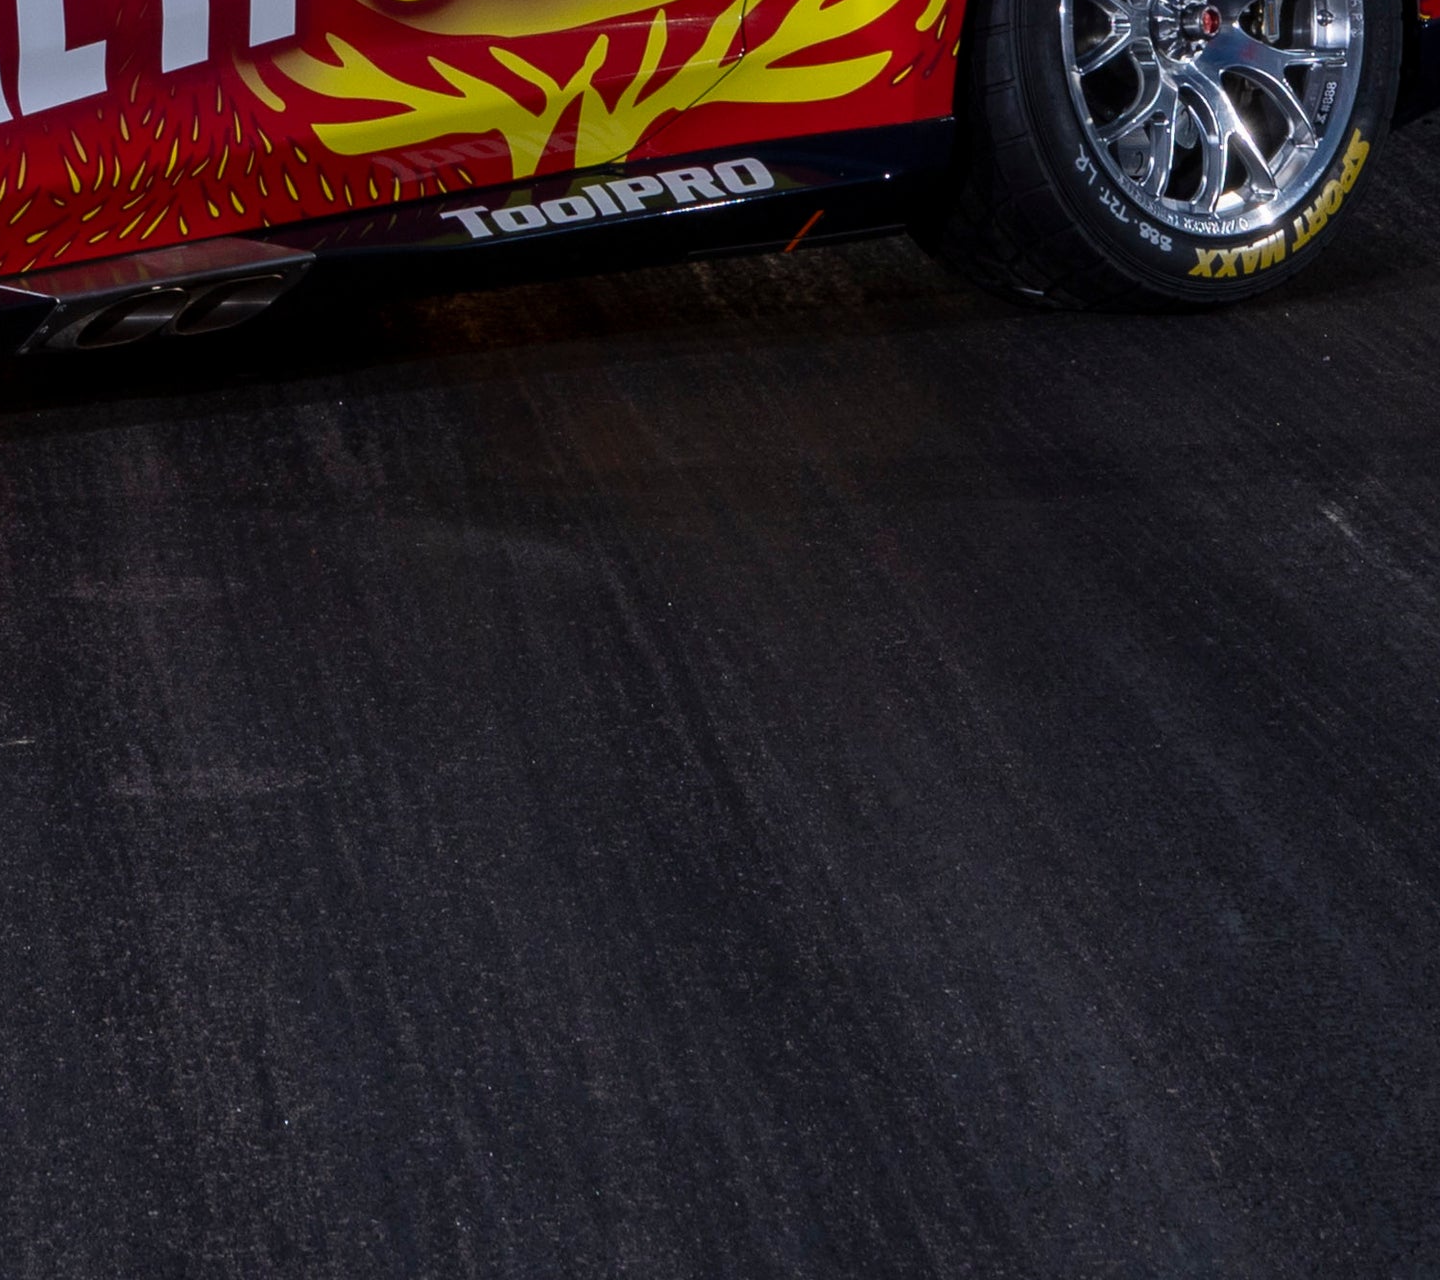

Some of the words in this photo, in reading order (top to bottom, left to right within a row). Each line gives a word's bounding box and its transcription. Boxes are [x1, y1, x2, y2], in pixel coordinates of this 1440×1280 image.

[1291, 127, 1370, 253] SPORT
[1138, 221, 1173, 253] 888
[1187, 228, 1286, 278] MAXX
